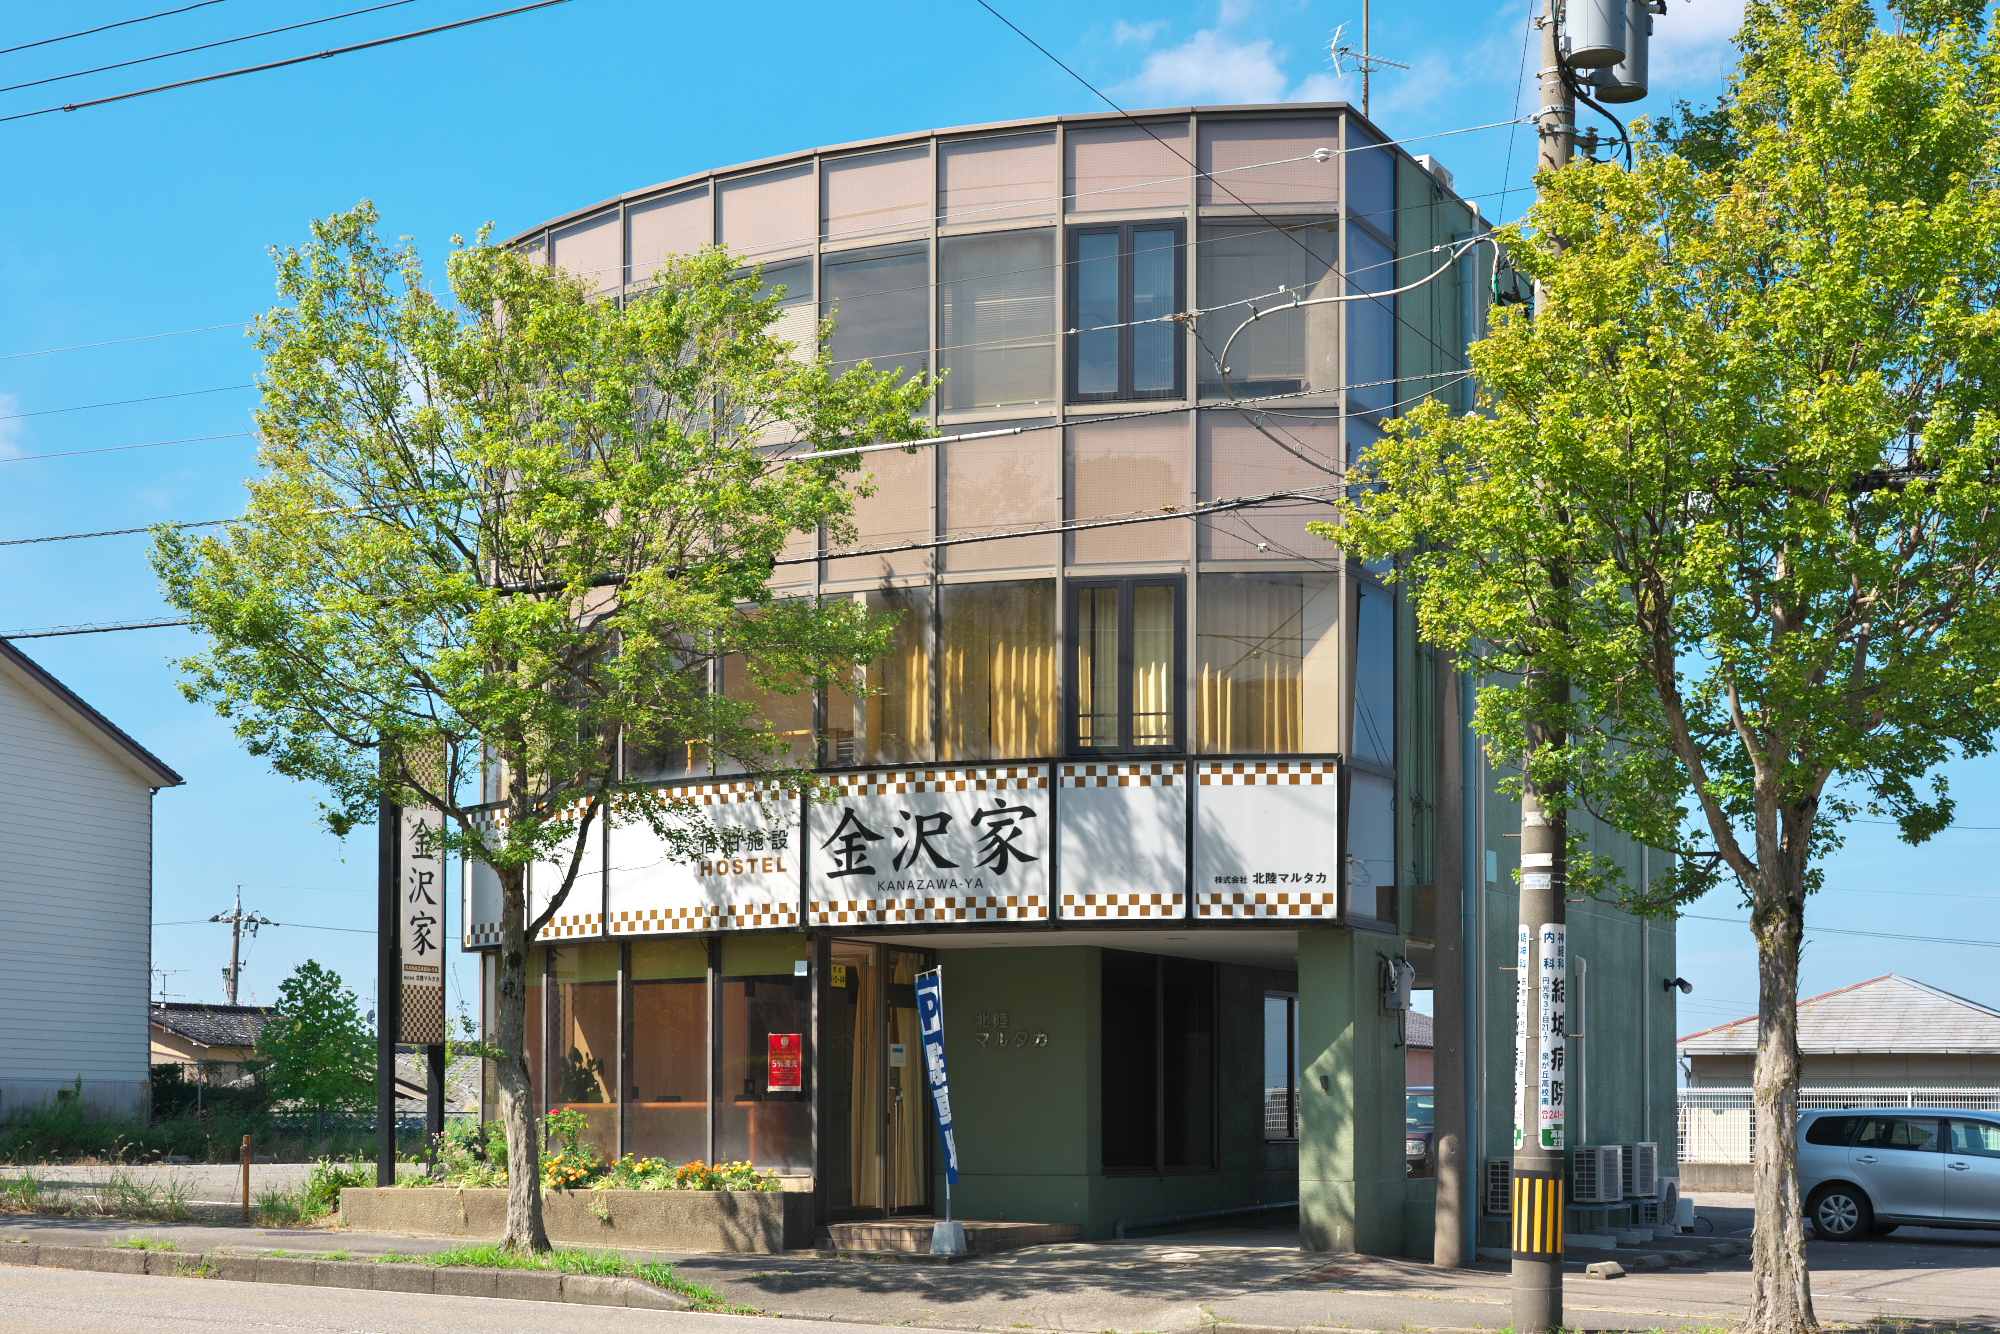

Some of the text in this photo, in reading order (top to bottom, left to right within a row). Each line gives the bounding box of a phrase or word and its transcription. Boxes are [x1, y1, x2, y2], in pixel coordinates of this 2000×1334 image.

[820, 797, 1039, 879] 金沢家
[700, 856, 788, 877] HOSTEL
[408, 817, 438, 956] 金沢家
[877, 877, 984, 892] KANAZAWA-YA
[1214, 872, 1328, 885] 株式会社 北陸マルタカ
[1543, 931, 1556, 971] 内科
[404, 964, 439, 973] KANAZAWA-YA
[918, 988, 940, 1034] P
[975, 1011, 1010, 1029] 北陸
[975, 1030, 1049, 1048] マルタカ
[1550, 976, 1565, 1106] 結城病院
[771, 1059, 798, 1068] 5%還元
[1541, 1052, 1550, 1106] 泉が丘高校南
